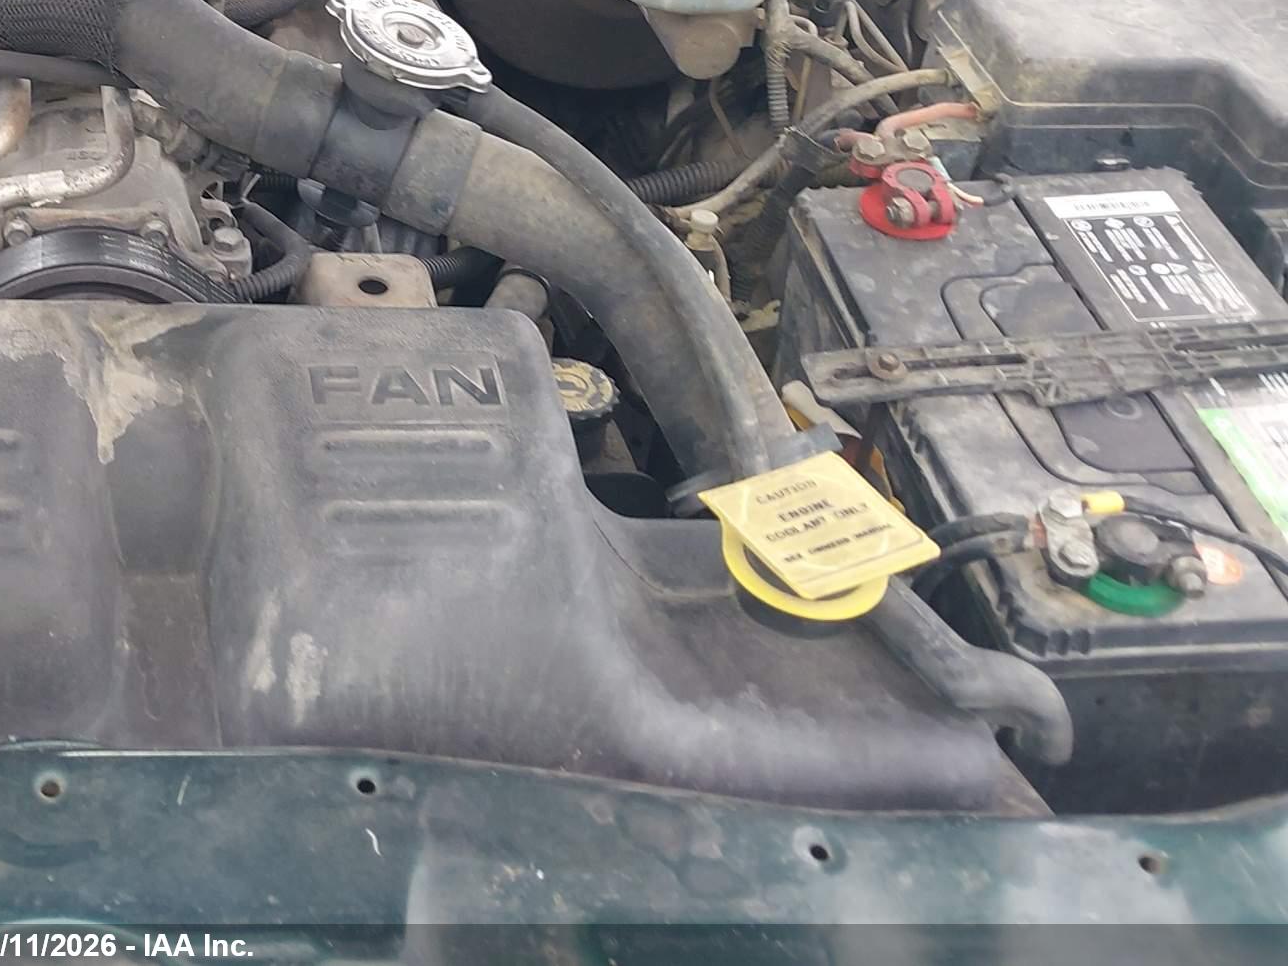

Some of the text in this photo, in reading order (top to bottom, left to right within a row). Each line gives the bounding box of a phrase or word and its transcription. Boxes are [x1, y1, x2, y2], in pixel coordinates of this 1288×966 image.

[307, 364, 504, 407] FAN
[755, 479, 817, 505] CAUTION
[765, 502, 870, 543] COOLANT ONLY
[778, 497, 833, 523] ENGINE
